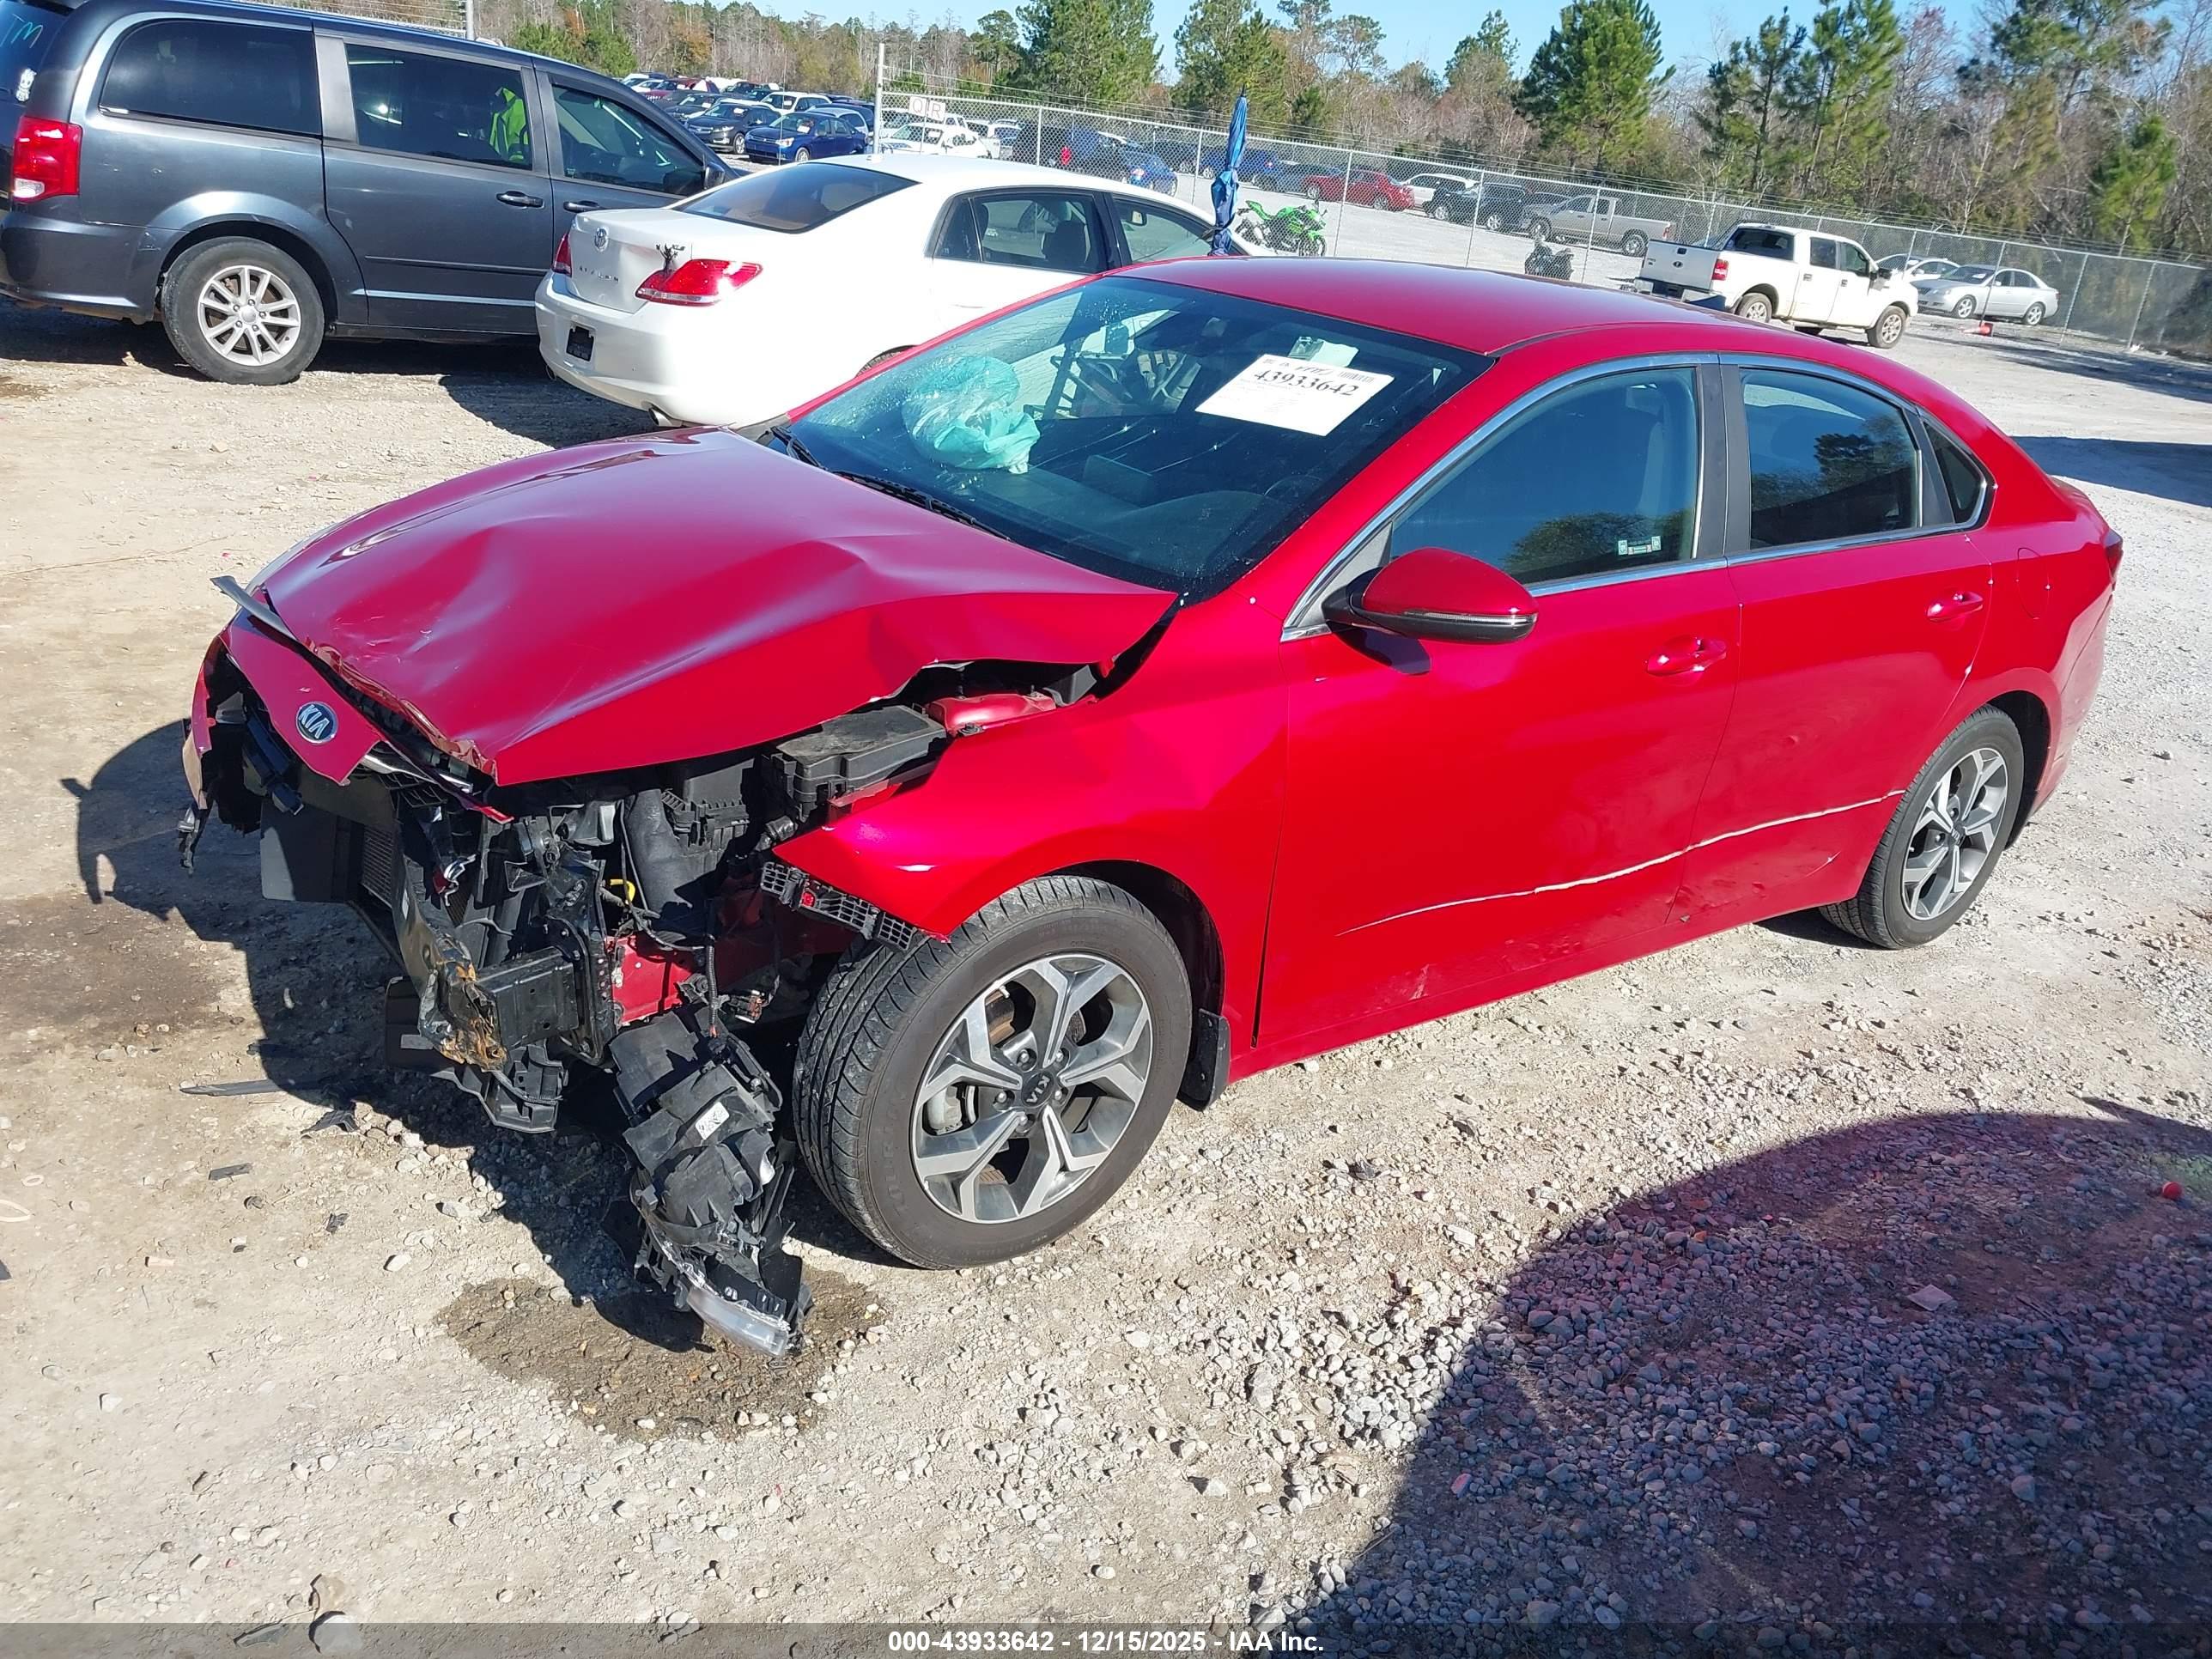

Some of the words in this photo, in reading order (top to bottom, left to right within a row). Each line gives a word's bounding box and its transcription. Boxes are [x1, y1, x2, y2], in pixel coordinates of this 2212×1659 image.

[1254, 369, 1359, 396] 43933642
[298, 704, 330, 739] KIA
[1026, 1075, 1050, 1103] KIA
